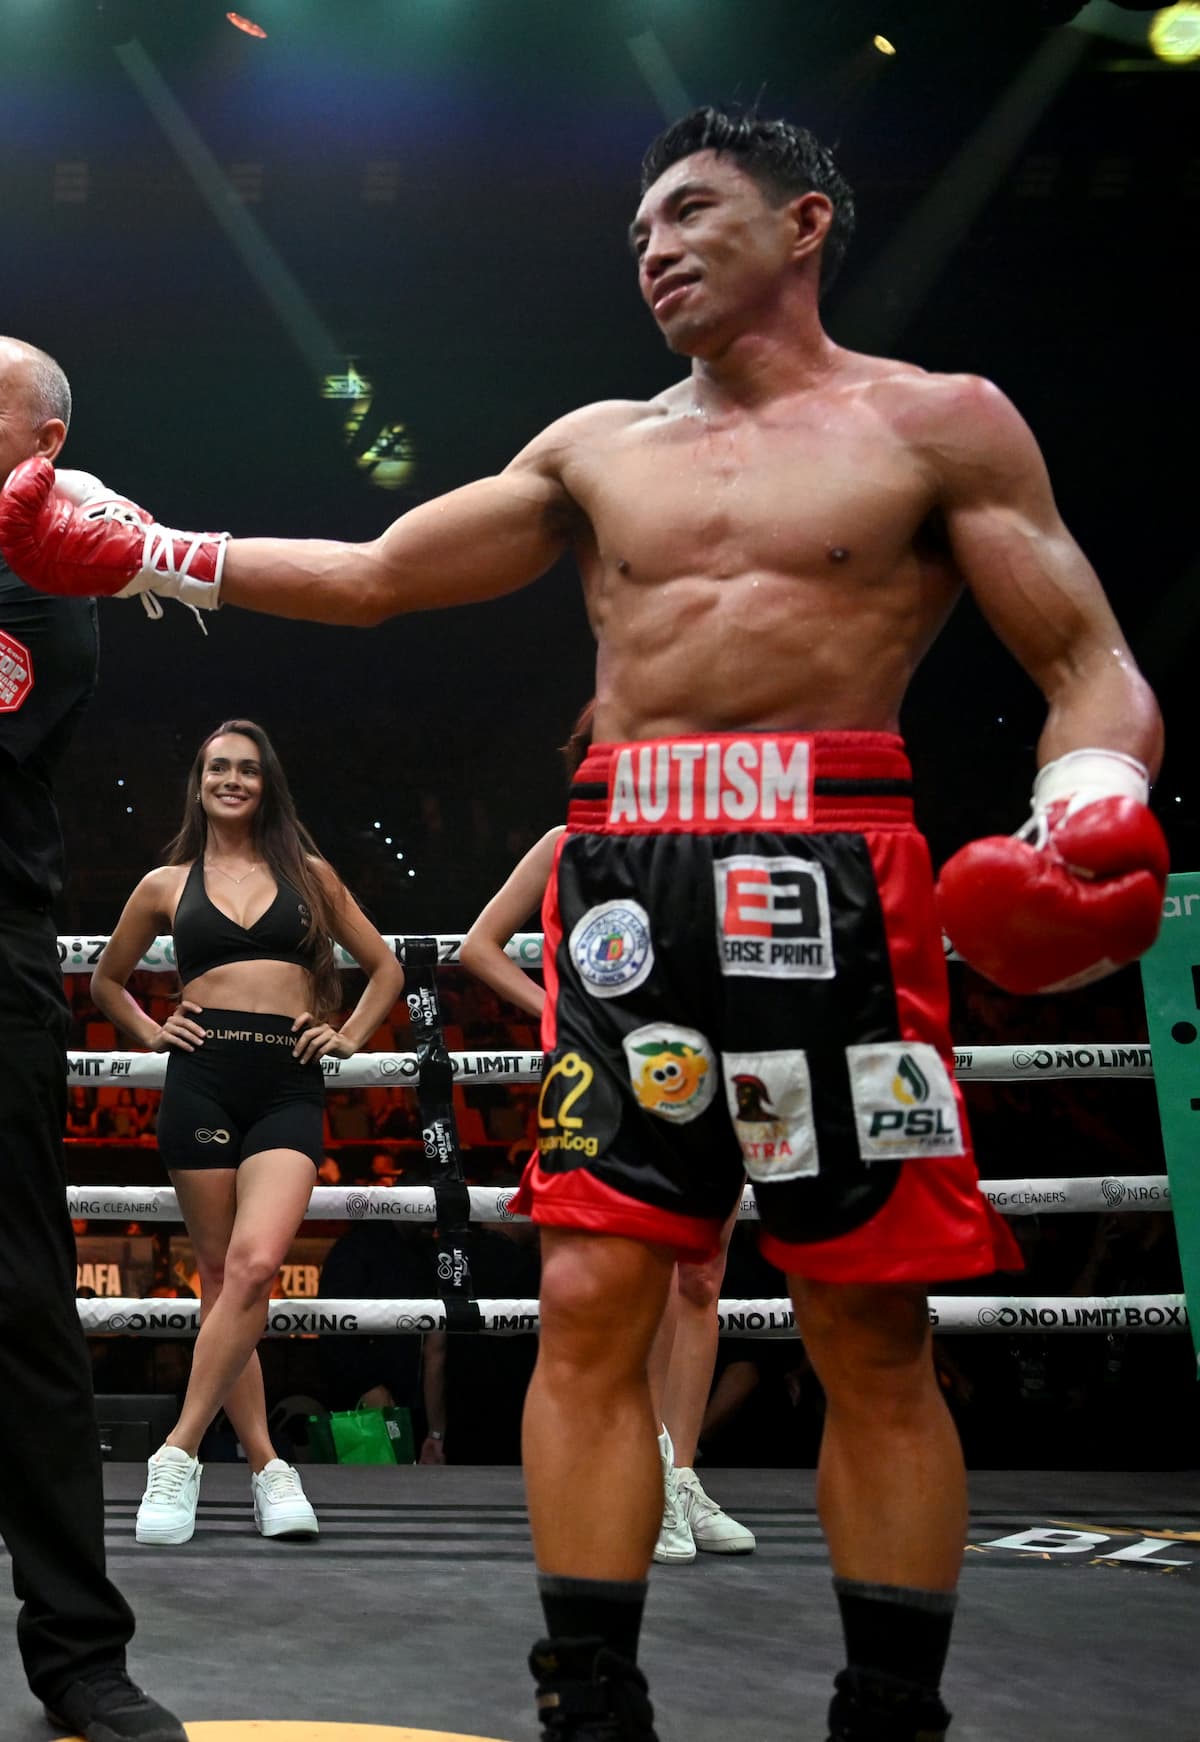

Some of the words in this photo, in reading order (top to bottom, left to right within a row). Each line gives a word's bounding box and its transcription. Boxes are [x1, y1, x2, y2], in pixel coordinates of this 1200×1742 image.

[609, 740, 810, 823] AUTISM
[724, 940, 765, 964] EASE
[769, 941, 826, 967] PRINT
[423, 1010, 434, 1026] NO
[216, 1030, 253, 1042] LIMIT
[255, 1033, 297, 1047] BOXIN
[463, 1057, 523, 1075] LIMIT
[530, 1058, 544, 1073] PP
[1056, 1050, 1095, 1068] NO
[67, 1059, 104, 1077] MIT
[110, 1061, 131, 1076] PPV
[868, 1109, 955, 1138] PSL
[438, 1147, 449, 1163] NO
[988, 1192, 1008, 1205] RG
[1011, 1191, 1066, 1204] CLEANERS
[1127, 1185, 1160, 1200] NRG
[68, 1201, 101, 1214] NRG
[103, 1201, 158, 1214] CLEANERS
[369, 1201, 401, 1215] NRG
[453, 1271, 462, 1287] NO
[150, 1314, 187, 1329] NO
[266, 1314, 359, 1331] OXING
[728, 1313, 765, 1330] NO
[1020, 1308, 1057, 1327] NO
[1063, 1308, 1120, 1326] LIMIT
[1125, 1307, 1189, 1327] BOX
